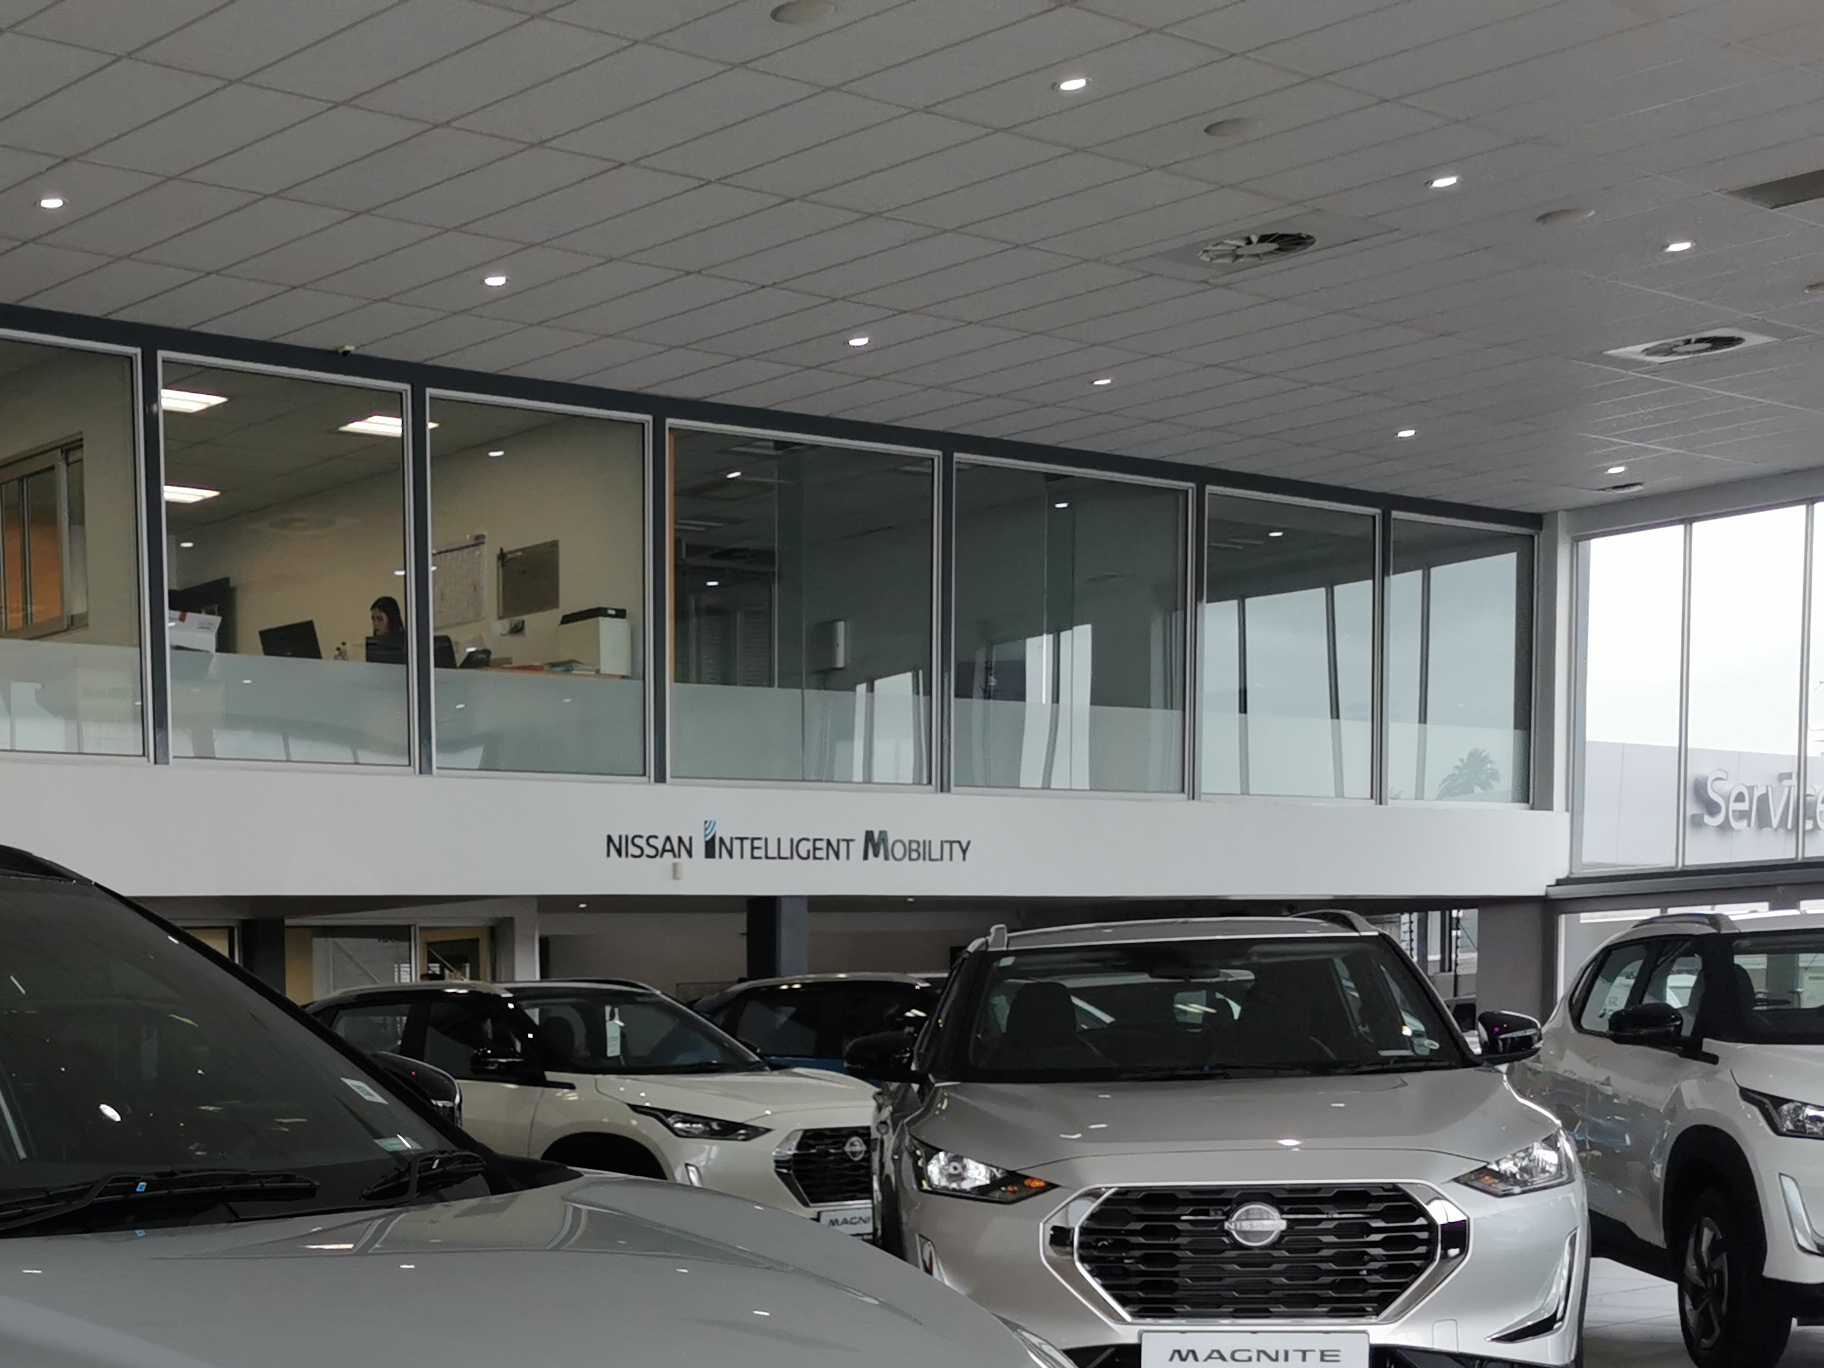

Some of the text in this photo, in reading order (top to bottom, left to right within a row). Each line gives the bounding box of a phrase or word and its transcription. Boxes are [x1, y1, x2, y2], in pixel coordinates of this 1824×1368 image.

[606, 820, 971, 862] NISSAN INTELLIGENT MOBILITY
[1168, 1349, 1342, 1363] MAGNITE
